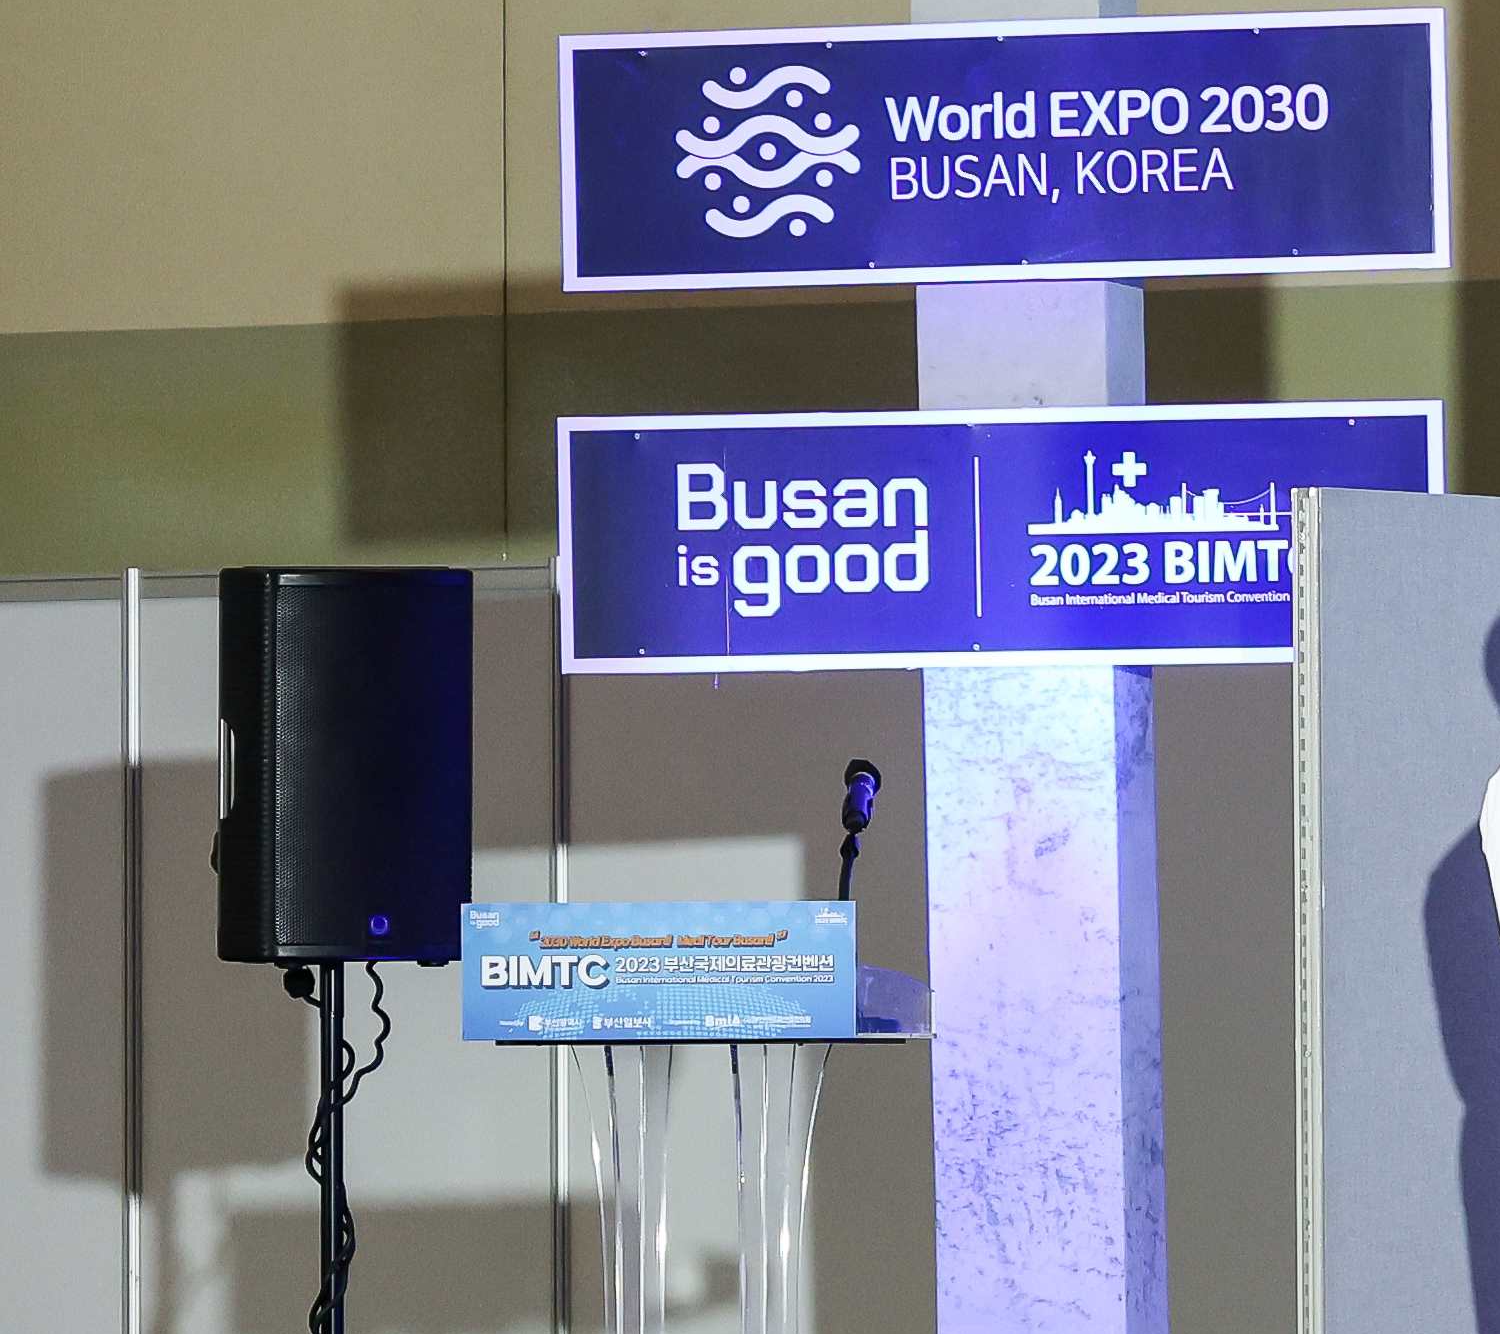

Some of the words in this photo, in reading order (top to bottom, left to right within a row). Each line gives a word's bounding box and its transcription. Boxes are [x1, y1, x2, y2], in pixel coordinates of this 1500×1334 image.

[885, 91, 1036, 142] World
[1050, 87, 1190, 137] EXPO
[1199, 83, 1329, 133] 2030
[890, 152, 1061, 203] BUSAN,
[1077, 147, 1235, 195] KOREA
[676, 463, 929, 531] Busan
[677, 544, 720, 587] is
[732, 529, 929, 617] good
[1029, 542, 1151, 586] 2023
[1163, 539, 1294, 585] BIMT
[1030, 593, 1063, 606] Busan
[1065, 592, 1136, 606] International
[1137, 591, 1181, 605] Medical
[1182, 590, 1225, 604] Tourism
[1227, 590, 1291, 604] Convention
[480, 954, 609, 989] BIMTC
[615, 955, 661, 973] 2023
[663, 954, 834, 973] 부산국제의료관광컨벤션
[615, 976, 641, 984] Busan
[642, 976, 696, 984] International
[813, 974, 834, 983] 2023
